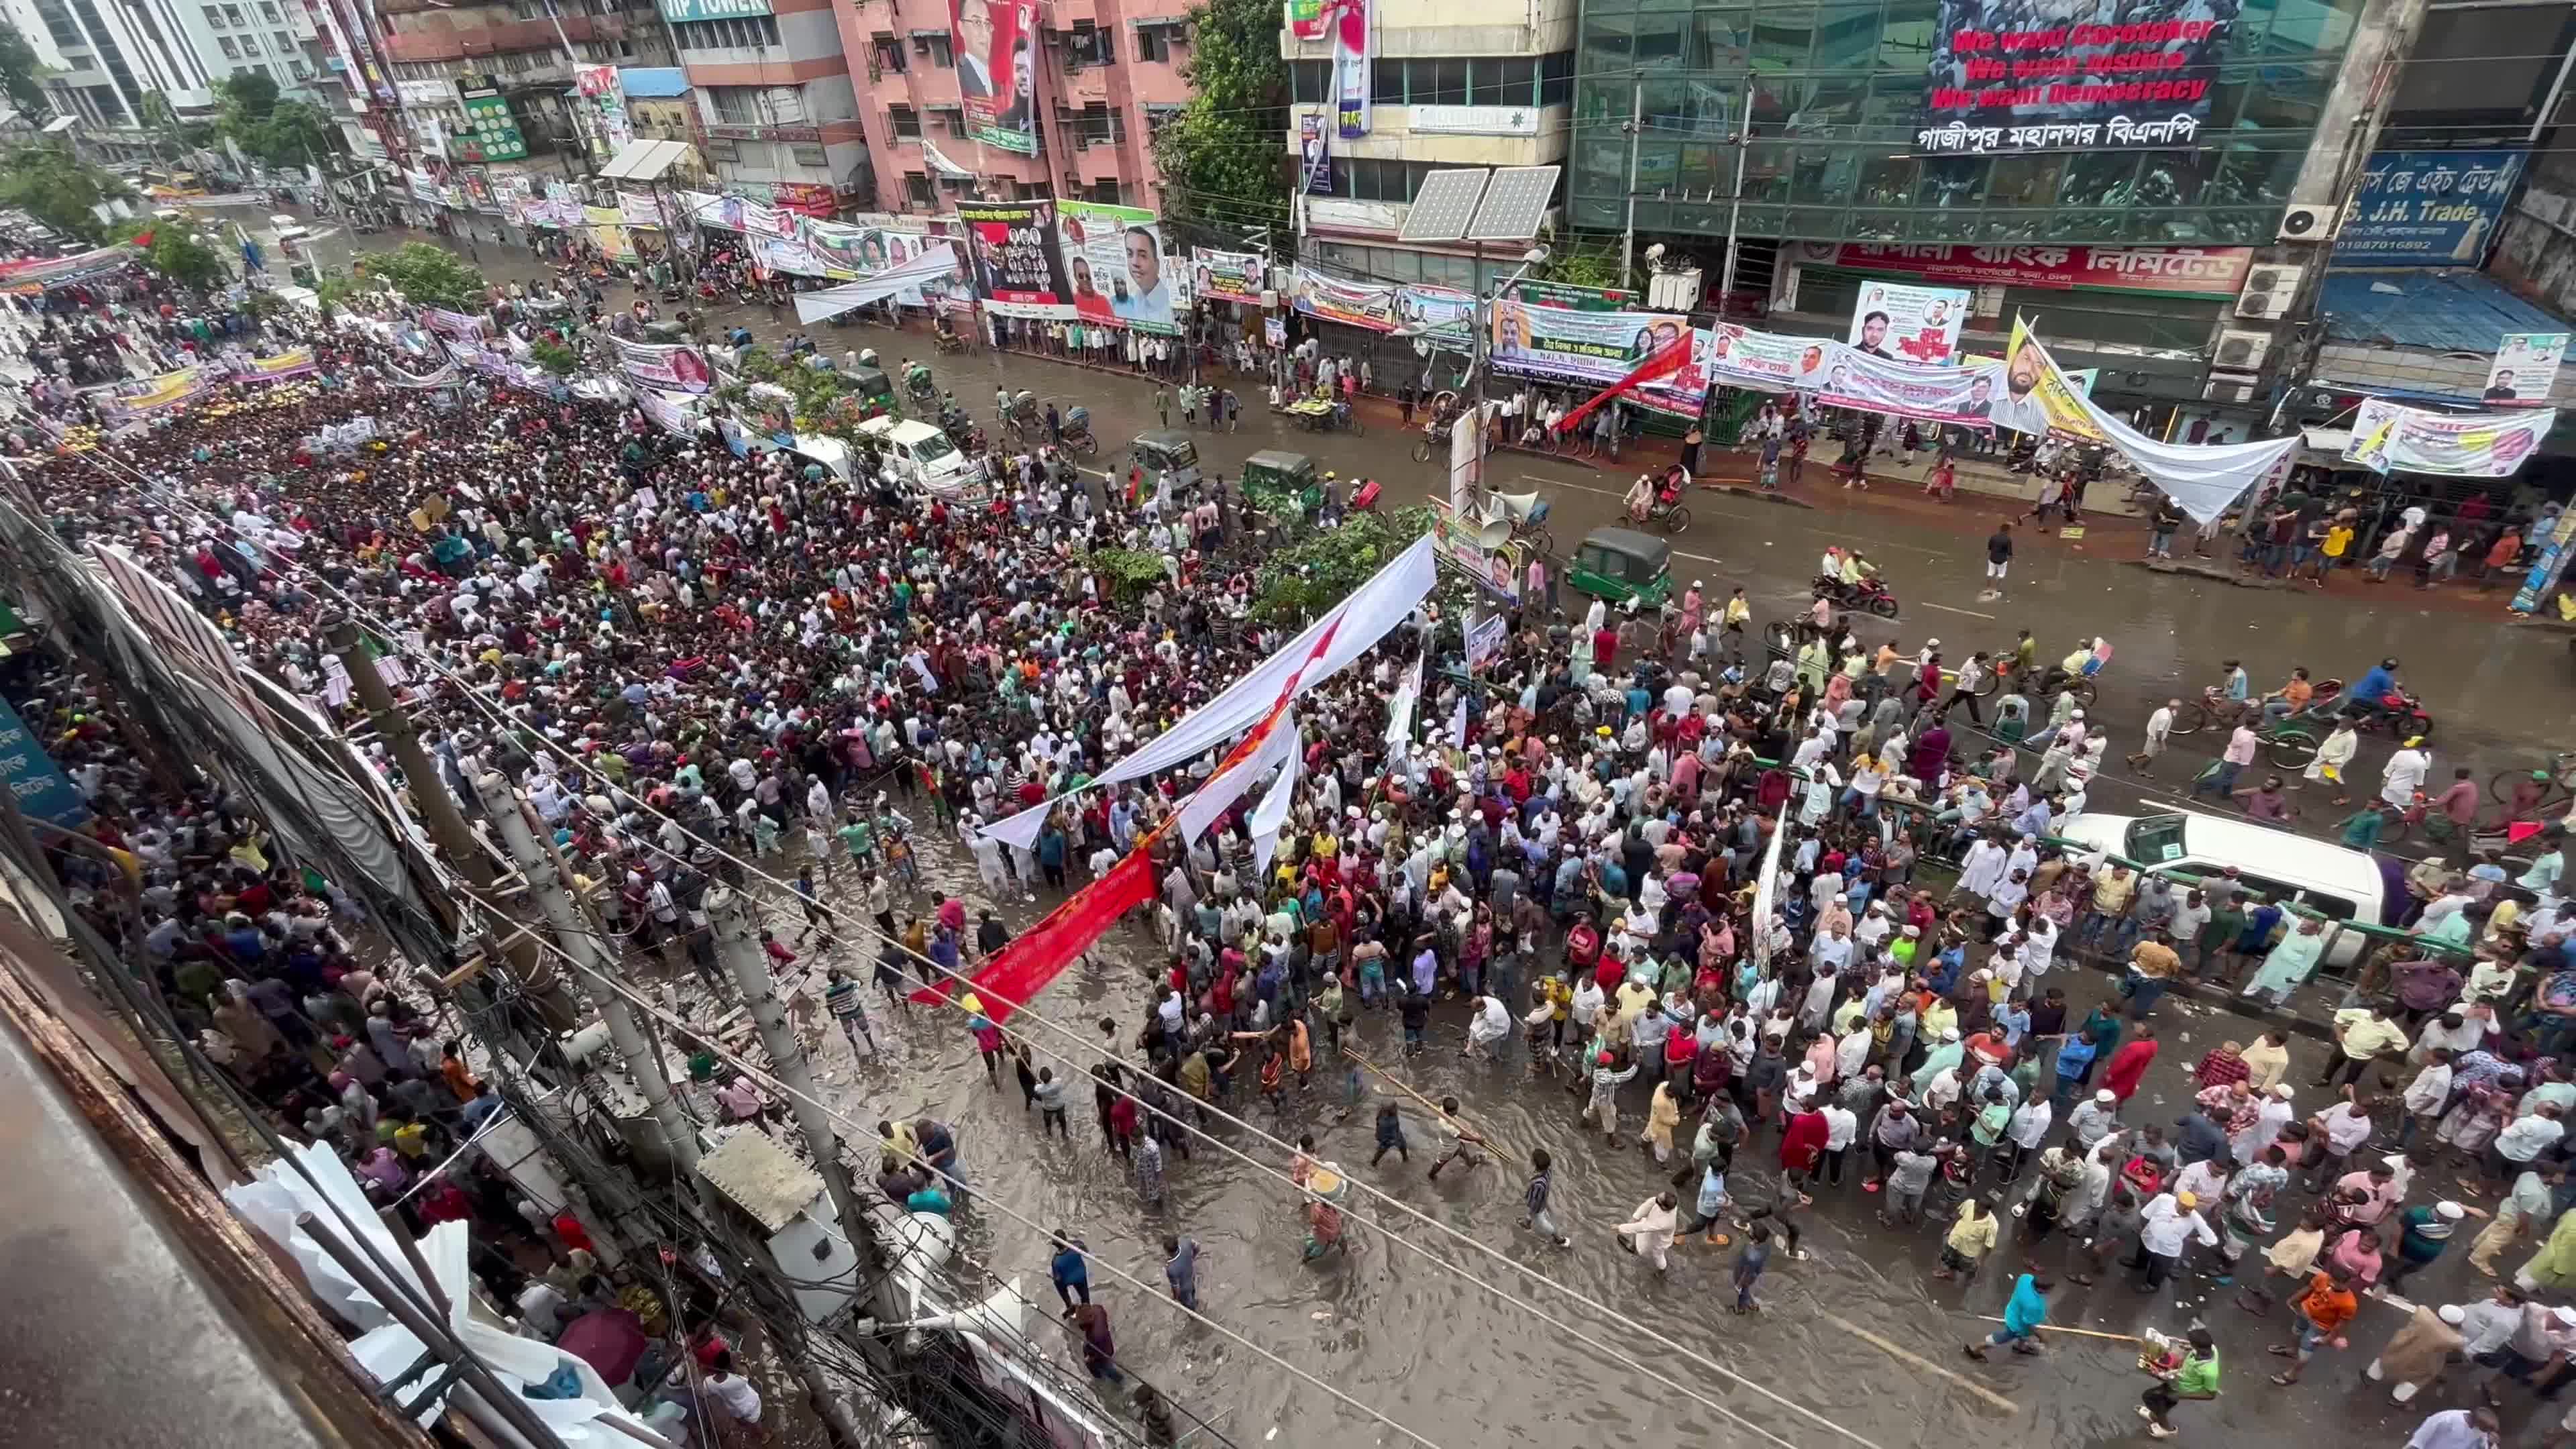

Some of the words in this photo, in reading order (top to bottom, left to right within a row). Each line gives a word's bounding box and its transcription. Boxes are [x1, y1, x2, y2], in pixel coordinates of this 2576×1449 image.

[1953, 28, 1996, 52] We
[1966, 58, 2006, 80] We
[1931, 87, 1972, 109] We
[1977, 87, 2043, 108] want
[2048, 79, 2208, 104] Democracy
[1918, 120, 2002, 153] গাজীপুর
[2008, 122, 2101, 149] মহানগর
[2105, 113, 2200, 145] বিএনপি
[2386, 170, 2415, 194] জে
[2369, 200, 2410, 221] J.H.
[2086, 246, 2244, 278] লিমিটেড
